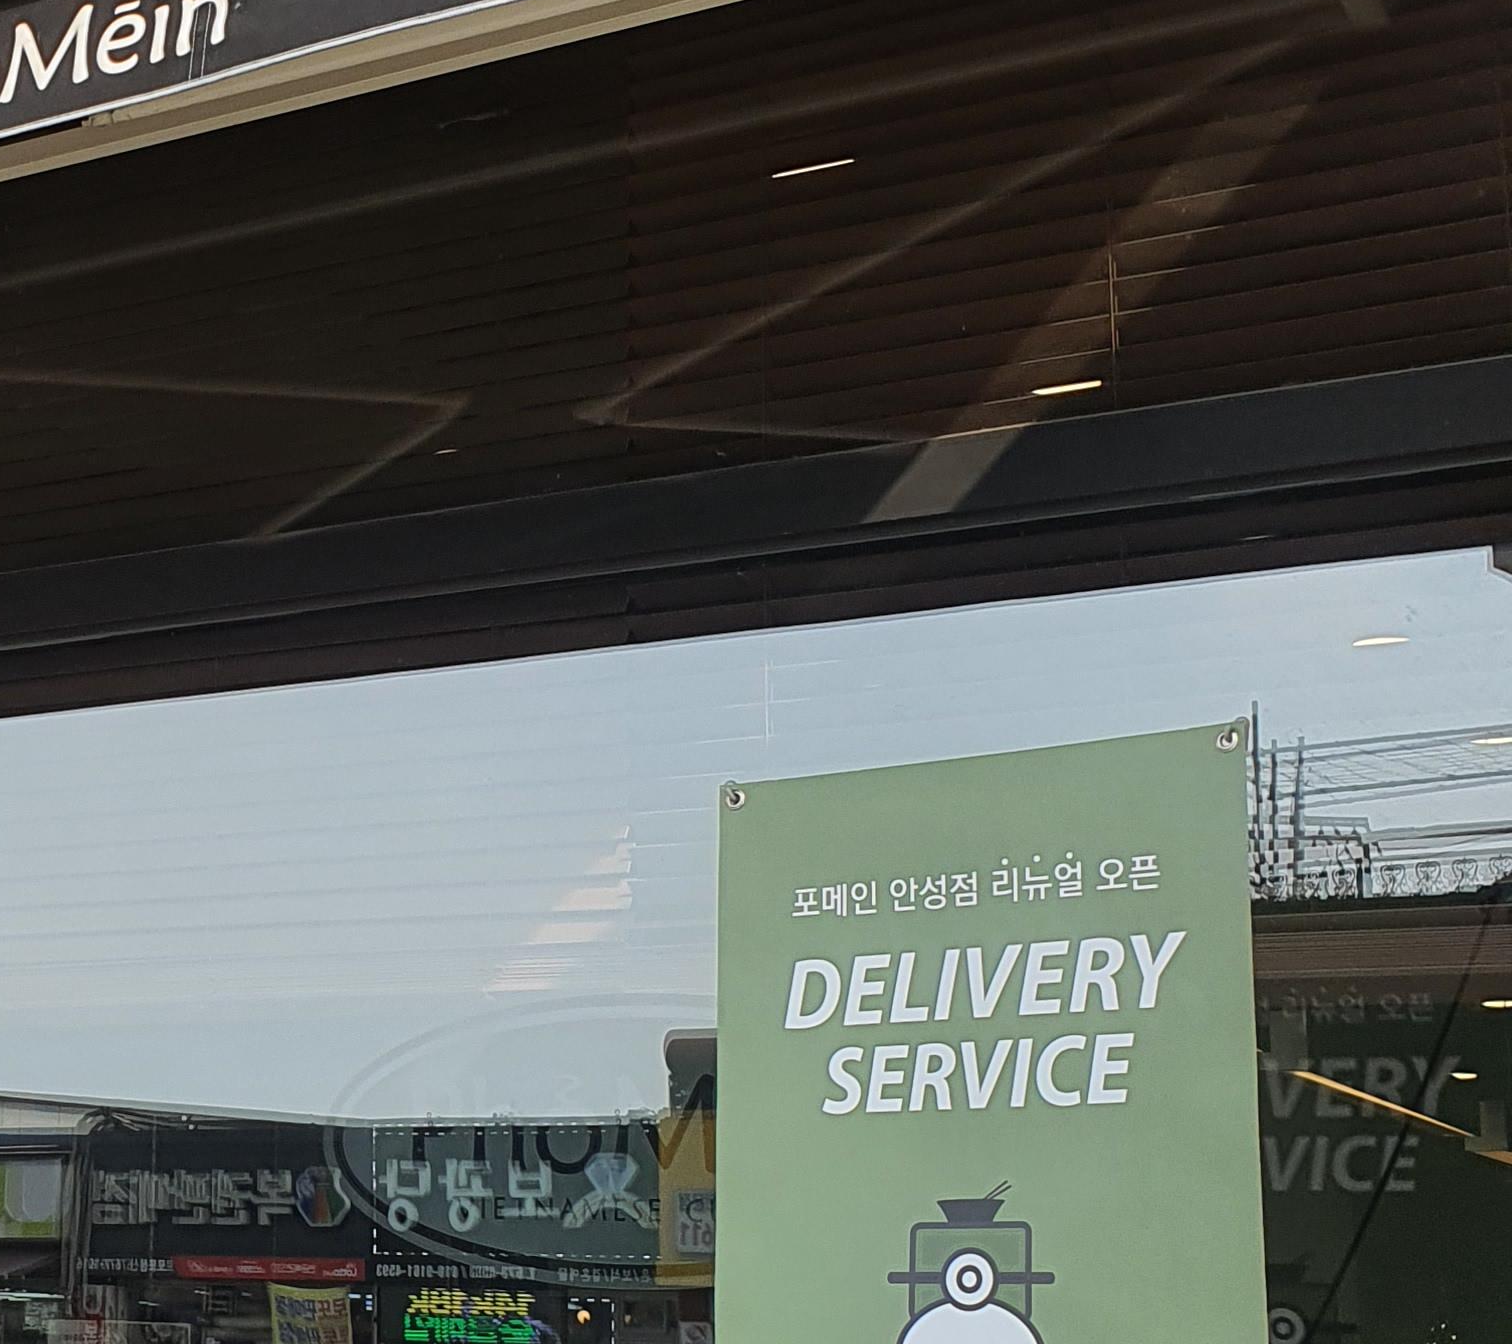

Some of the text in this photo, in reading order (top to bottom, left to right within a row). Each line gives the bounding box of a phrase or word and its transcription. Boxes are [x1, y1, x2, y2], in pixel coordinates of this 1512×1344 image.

[791, 854, 1161, 918] 포메인 안성점 리뉴얼 오픈
[783, 929, 1188, 1031] DELIVERY
[821, 1032, 1135, 1116] SERVICE
